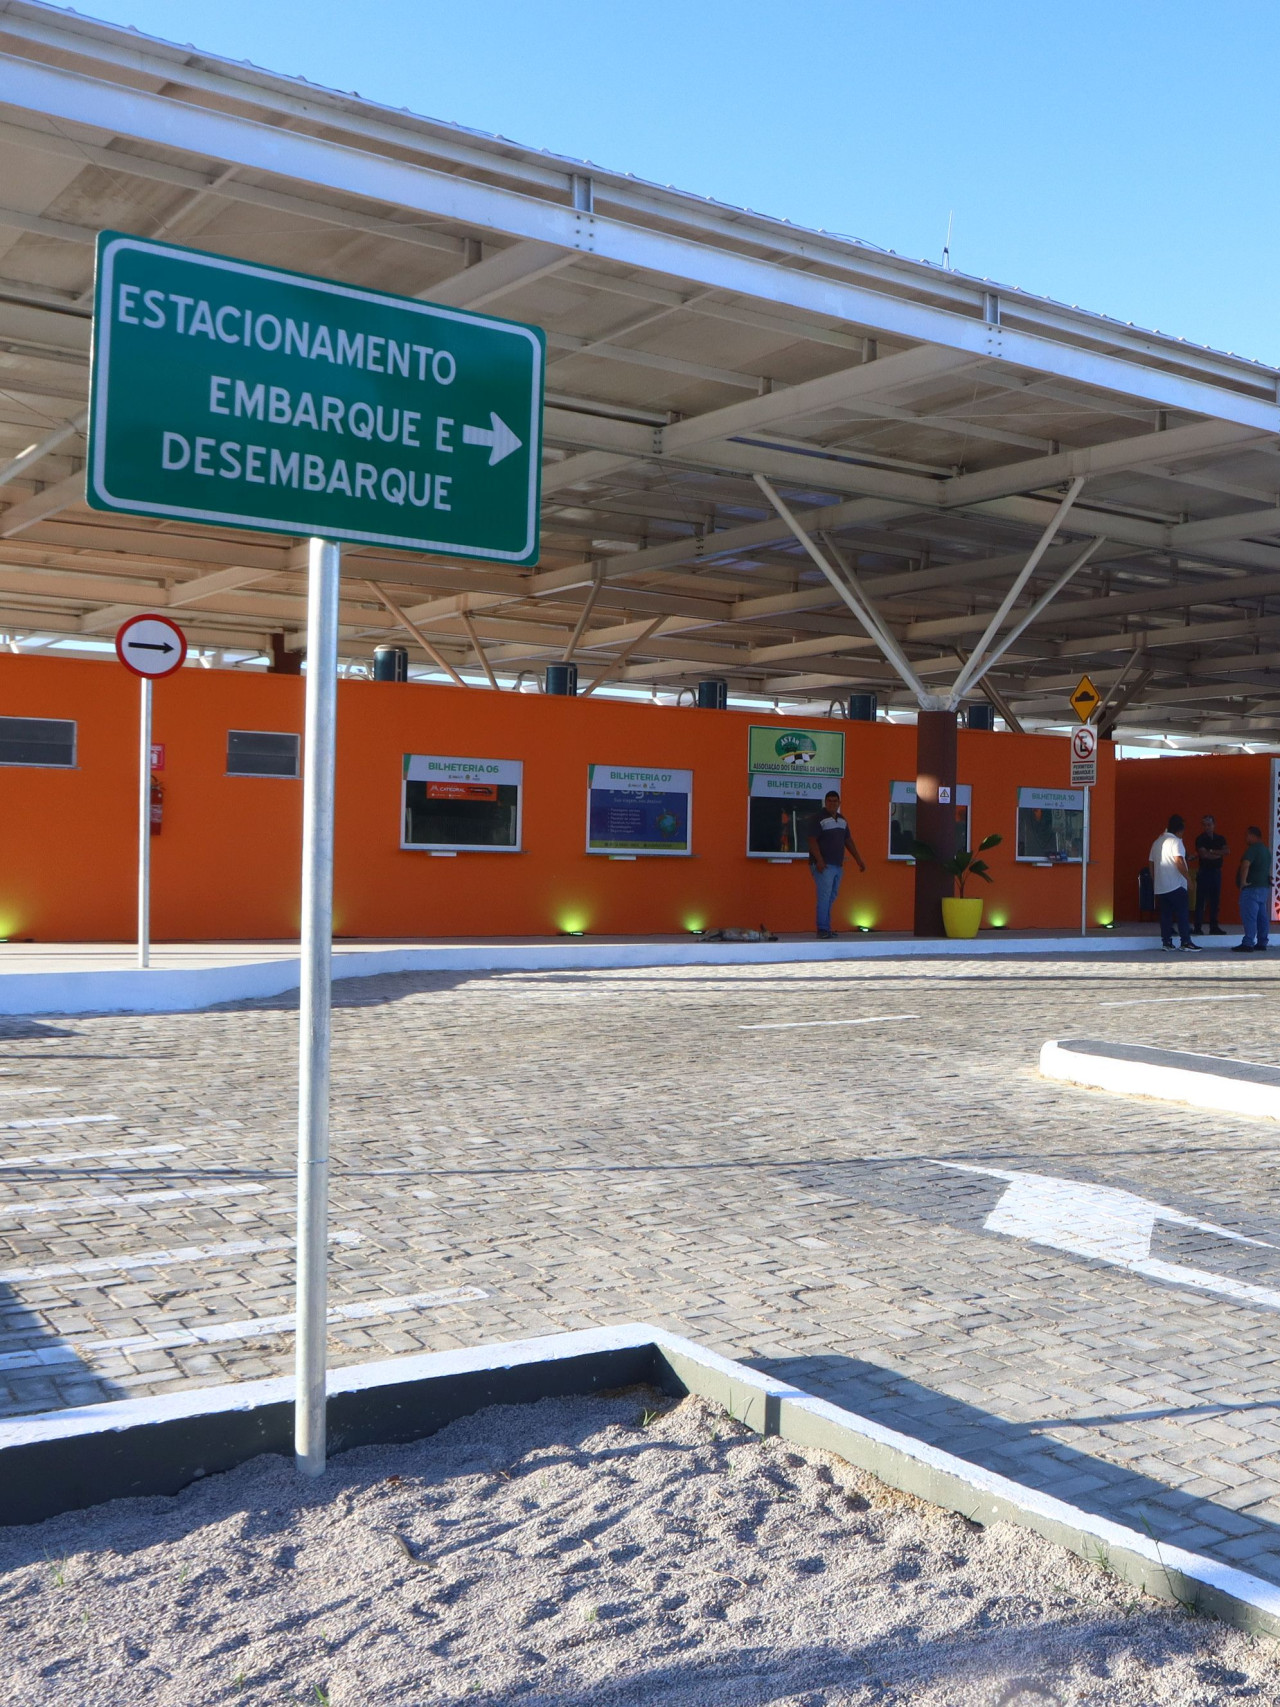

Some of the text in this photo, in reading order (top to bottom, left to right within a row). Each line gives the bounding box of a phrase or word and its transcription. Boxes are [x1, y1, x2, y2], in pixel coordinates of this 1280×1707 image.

[118, 284, 456, 385] ESTACIONAMENTO
[209, 375, 455, 453] EMBARQUE E
[162, 431, 453, 512] DESEMBARQUE
[428, 761, 499, 774] BILHETERIA 06
[610, 771, 672, 783] BILHETERIA 07
[767, 780, 823, 790] BILHETERIA 08
[1031, 792, 1067, 801] BILHETERIA
